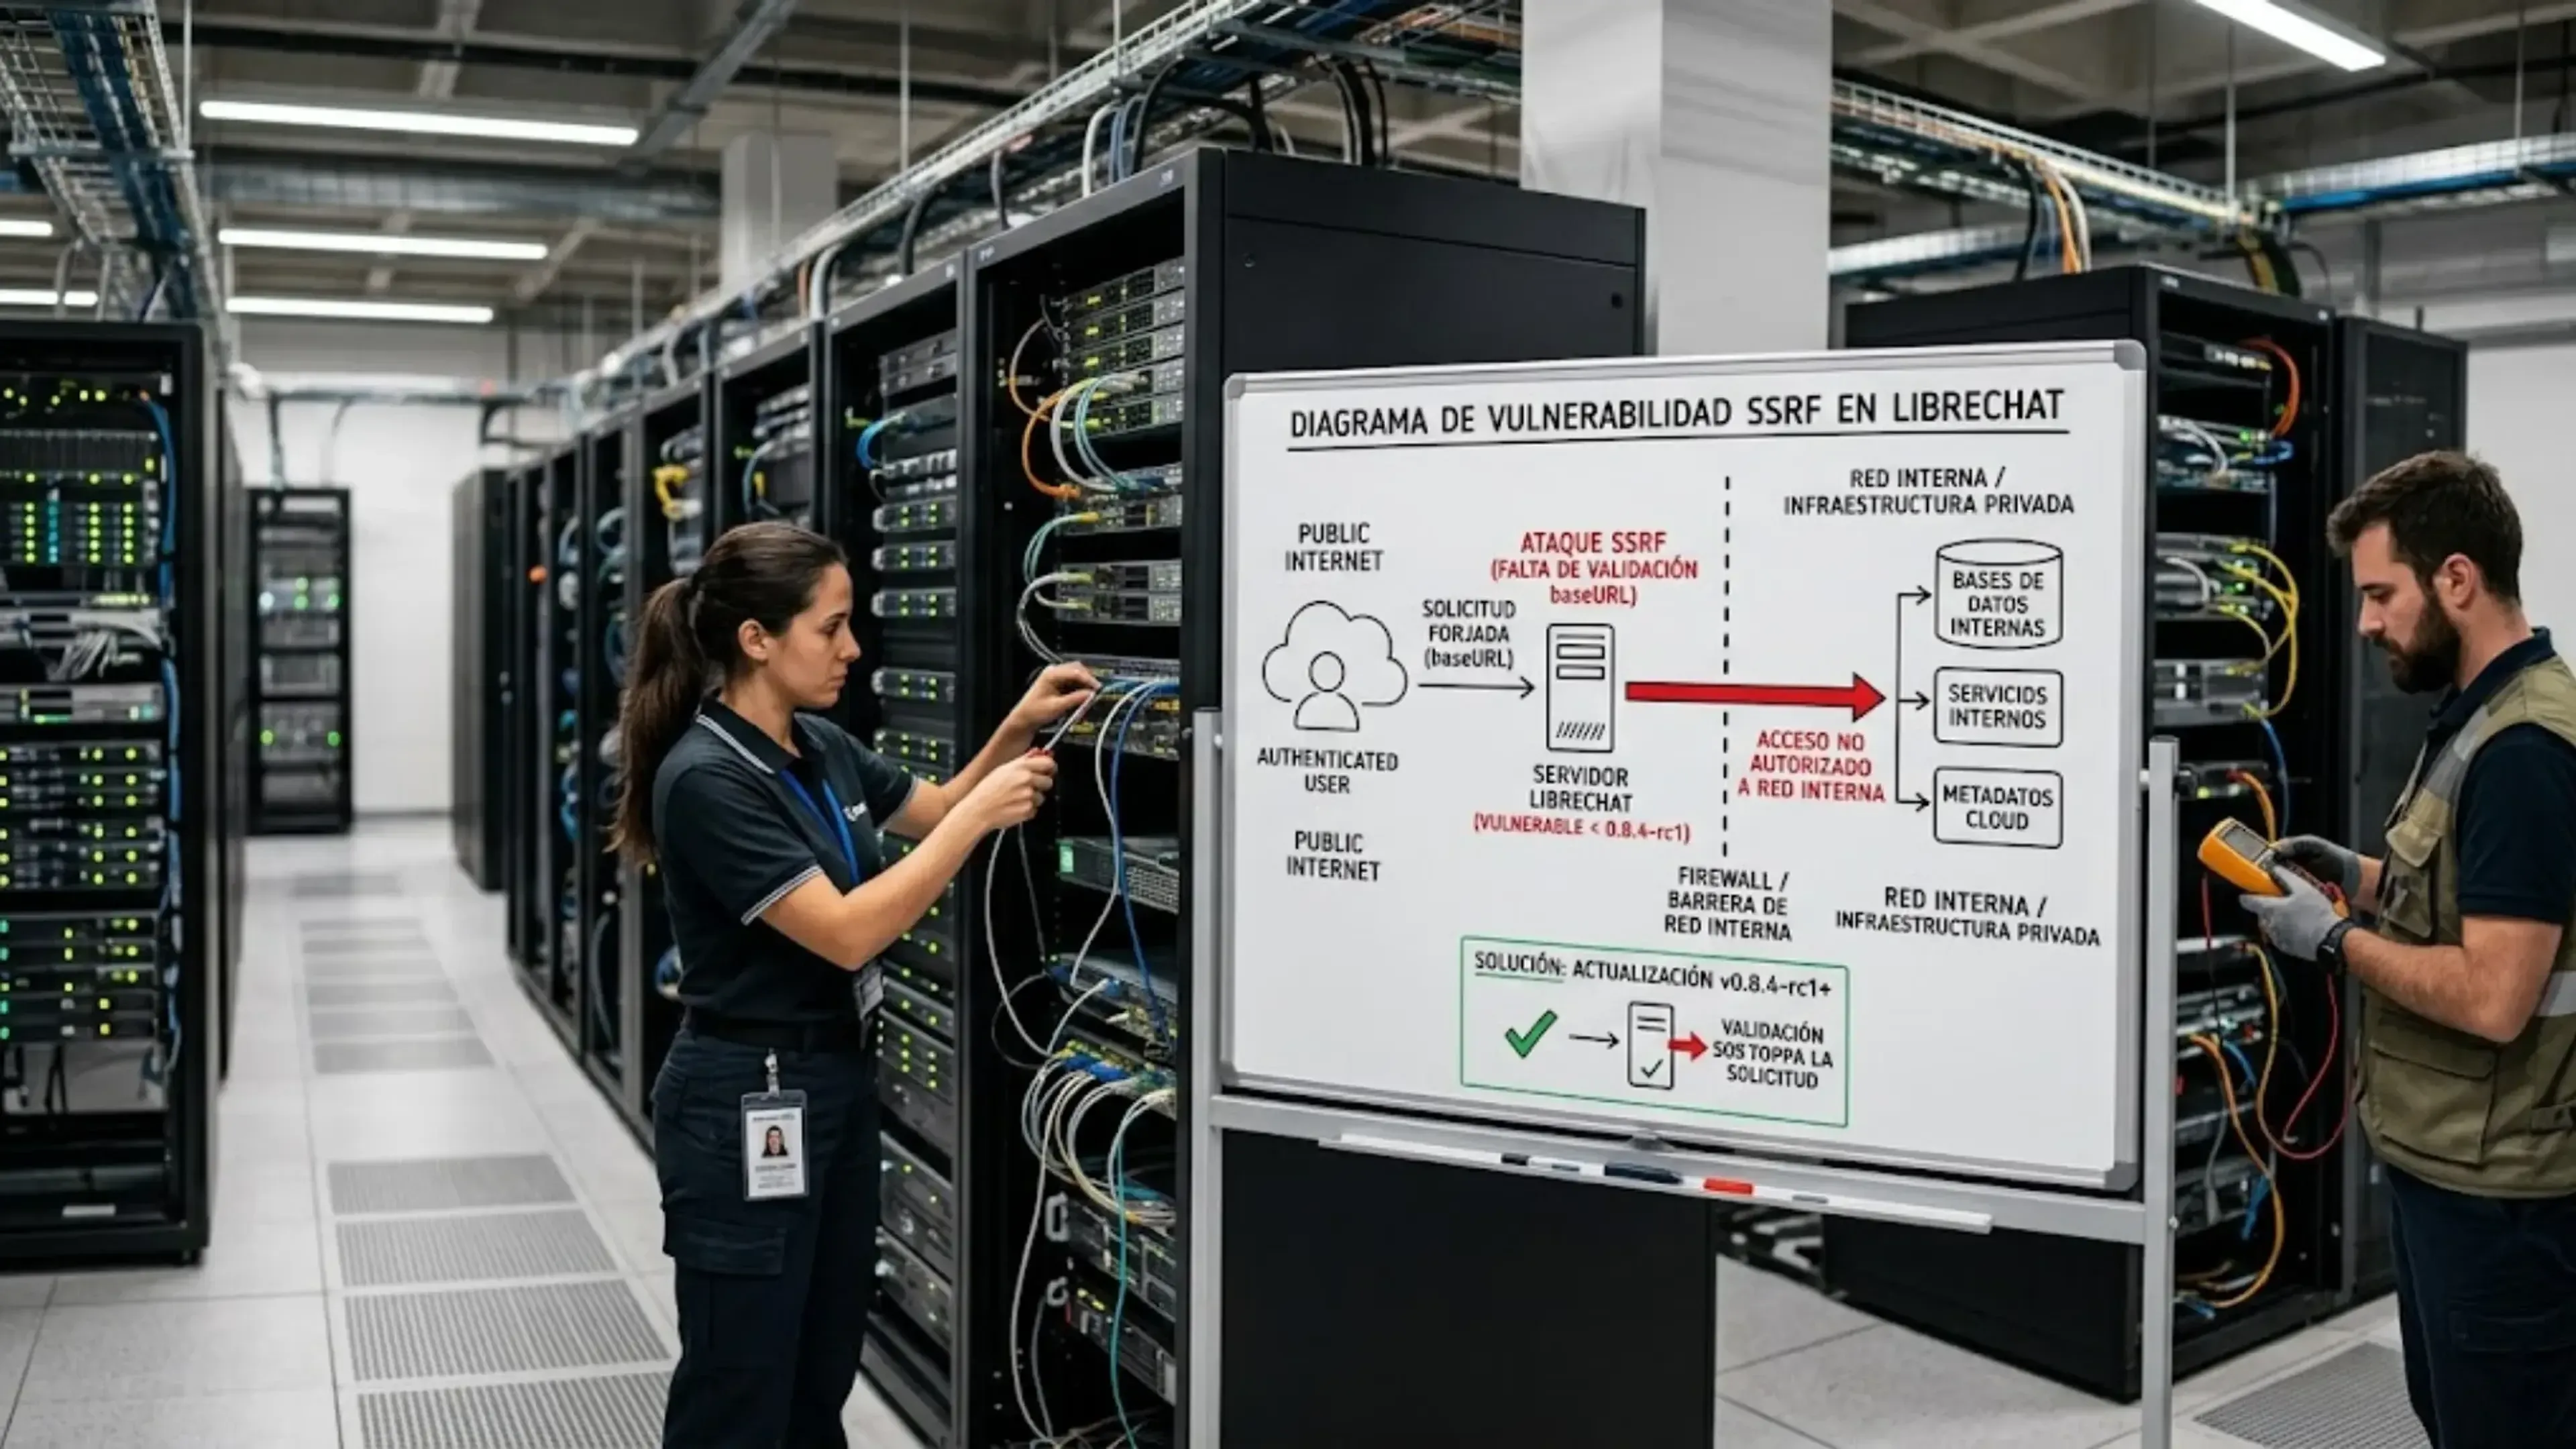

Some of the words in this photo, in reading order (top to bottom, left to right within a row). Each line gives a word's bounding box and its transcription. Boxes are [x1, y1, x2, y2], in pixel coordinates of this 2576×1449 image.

[1291, 409, 1429, 439] DIAGRAMA
[1441, 405, 1475, 434] DE
[1487, 396, 1733, 433] VULNERABILIDAD
[1746, 394, 1822, 426] SSRF
[1837, 392, 1877, 422] EN
[1893, 388, 2065, 423] LIBRECHAT
[1849, 468, 1890, 488] RED
[1897, 467, 1988, 488] INTERNA
[1994, 465, 2006, 489] /
[1784, 494, 1978, 516] INFRAESTRUCTURA
[1984, 493, 2075, 515] PRIVADA
[1298, 521, 1371, 545] PUBLIC
[1520, 531, 1603, 554] ATAQUE
[1611, 531, 1667, 554] SSRF
[1285, 549, 1384, 572] INTERNET
[1491, 559, 1551, 582] (FALTA
[1557, 559, 1580, 579] DE
[1587, 554, 1698, 580] VALIDACIÓN
[1953, 572, 2013, 590] BASES
[2019, 571, 2044, 591] DE
[1550, 584, 1638, 608] baseURL)
[1968, 594, 2029, 614] DATOS
[1421, 598, 1517, 619] SOLICITUD
[1428, 623, 1510, 643] FORJADA
[1950, 616, 2046, 638] INTERNAS
[1424, 647, 1514, 672] (baseURL)
[1949, 707, 2047, 730] INTERNOS
[1756, 729, 1830, 751] ACCESO
[1837, 732, 1865, 752] NO
[1256, 747, 1399, 771] AUTHENTICATED
[1750, 753, 1872, 777] AUTORIZADO
[1304, 773, 1350, 794] USER
[1533, 763, 1629, 788] SERVIDOR
[1529, 789, 1633, 813] LIBRECHAT
[1737, 777, 1750, 796] A
[1757, 778, 1794, 799] RED
[1801, 780, 1886, 803] INTERNA
[1943, 784, 2054, 808] METADATOS
[1474, 812, 1583, 835] (VULNERABLE
[1605, 820, 1690, 845] 0.8.4-rc1)
[1966, 809, 2029, 831] CLOUD
[1295, 830, 1363, 854] PUBLIC
[1287, 855, 1381, 882] INTERNET
[1678, 865, 1773, 892] FIREWALL
[1778, 871, 1790, 893] /
[1667, 890, 1756, 914] BARRERA
[1762, 896, 1788, 916] DE
[1884, 885, 1927, 910] RED
[1935, 890, 2030, 918] INTERNA
[2036, 896, 2048, 919] /
[1664, 914, 1702, 935] RED
[1707, 917, 1792, 942] INTERNA
[1836, 912, 2011, 941] INFRAESTRUCTURA
[2017, 922, 2101, 947] PRIVADA
[1474, 951, 1567, 977] SOLUCIÓN:
[1572, 959, 1713, 989] ACTUALIZACIÓN
[1719, 972, 1832, 998] v0.8.4-rc1+
[1721, 1018, 1824, 1044] VALIDACIÓN
[1811, 1049, 1834, 1069] LA
[1727, 1063, 1819, 1090] SOLICITUD
